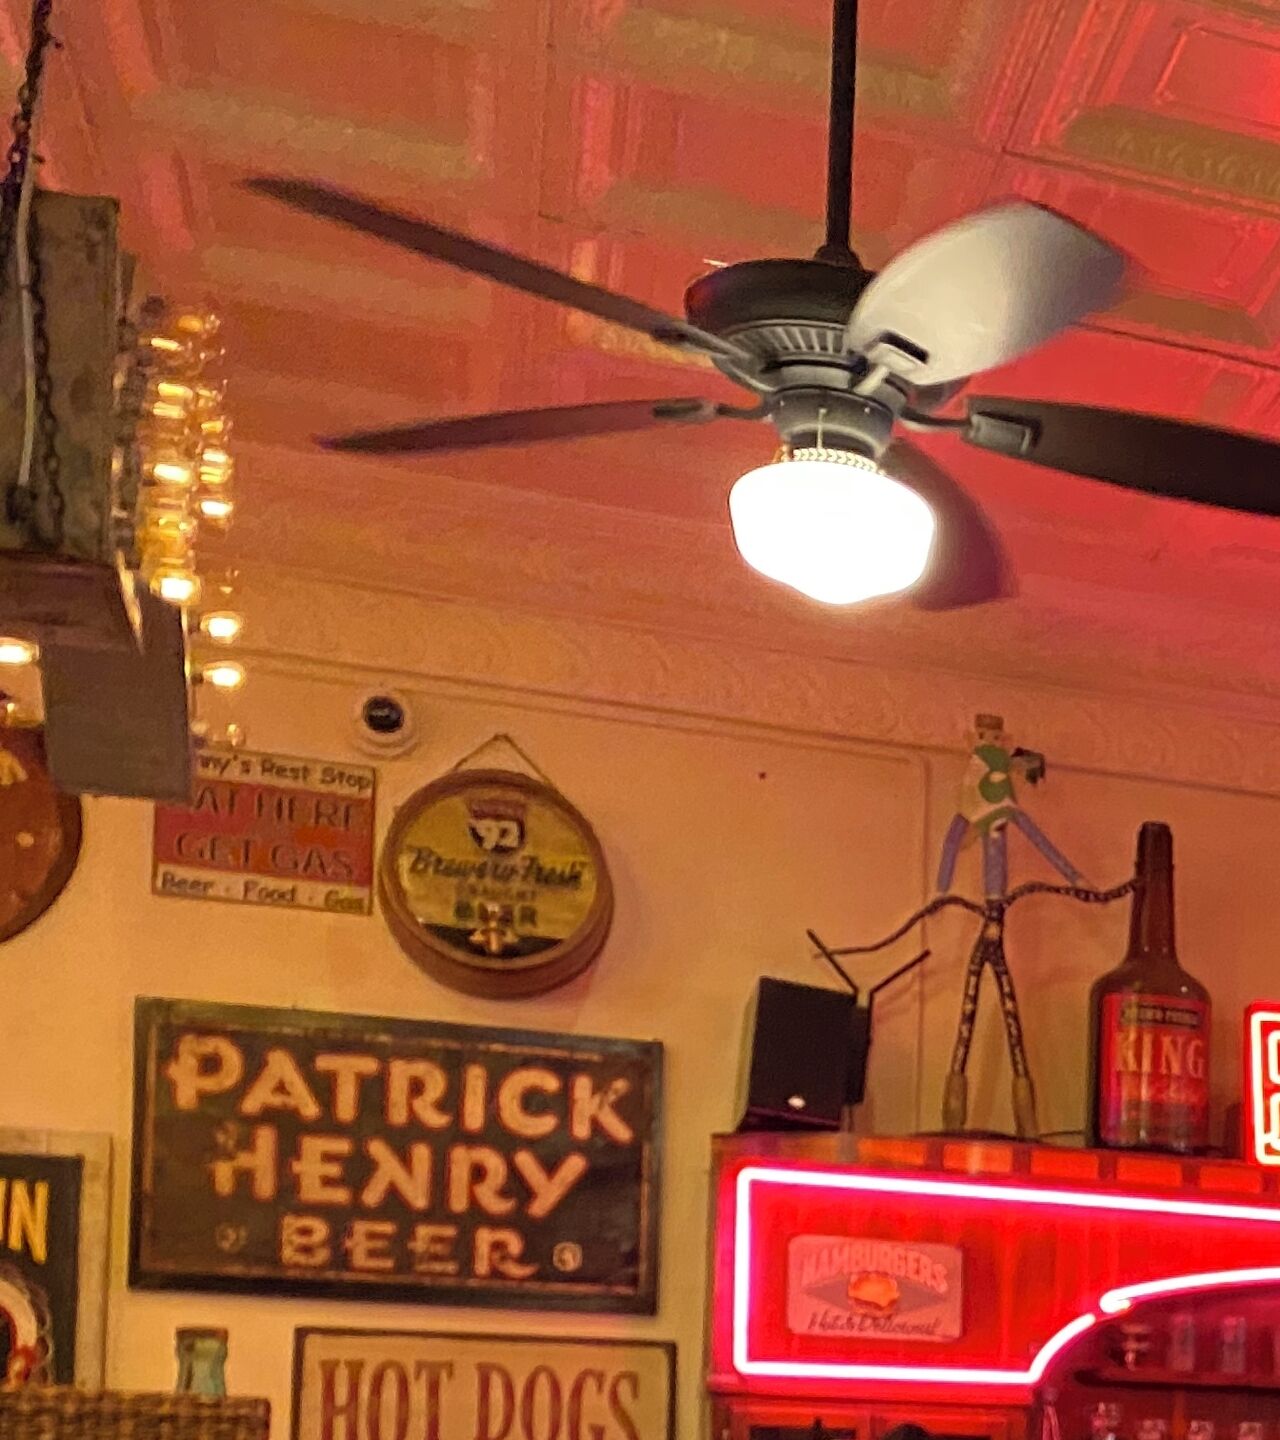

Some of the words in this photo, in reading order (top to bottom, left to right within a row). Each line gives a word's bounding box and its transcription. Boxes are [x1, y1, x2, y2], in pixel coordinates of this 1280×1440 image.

[201, 755, 250, 776] ny's
[260, 758, 310, 782] Rest
[319, 766, 373, 792] Stop
[195, 785, 241, 815] AT
[175, 831, 258, 865] GET
[270, 844, 354, 878] GAS
[161, 870, 214, 893] Beer
[243, 879, 297, 903] Food
[322, 888, 366, 910] Gas
[1116, 1031, 1206, 1079] KING
[165, 1033, 634, 1143] PATRICK
[209, 1124, 589, 1219] HENRY
[280, 1212, 541, 1279] BEER
[801, 1242, 949, 1294] HAMBURGERS
